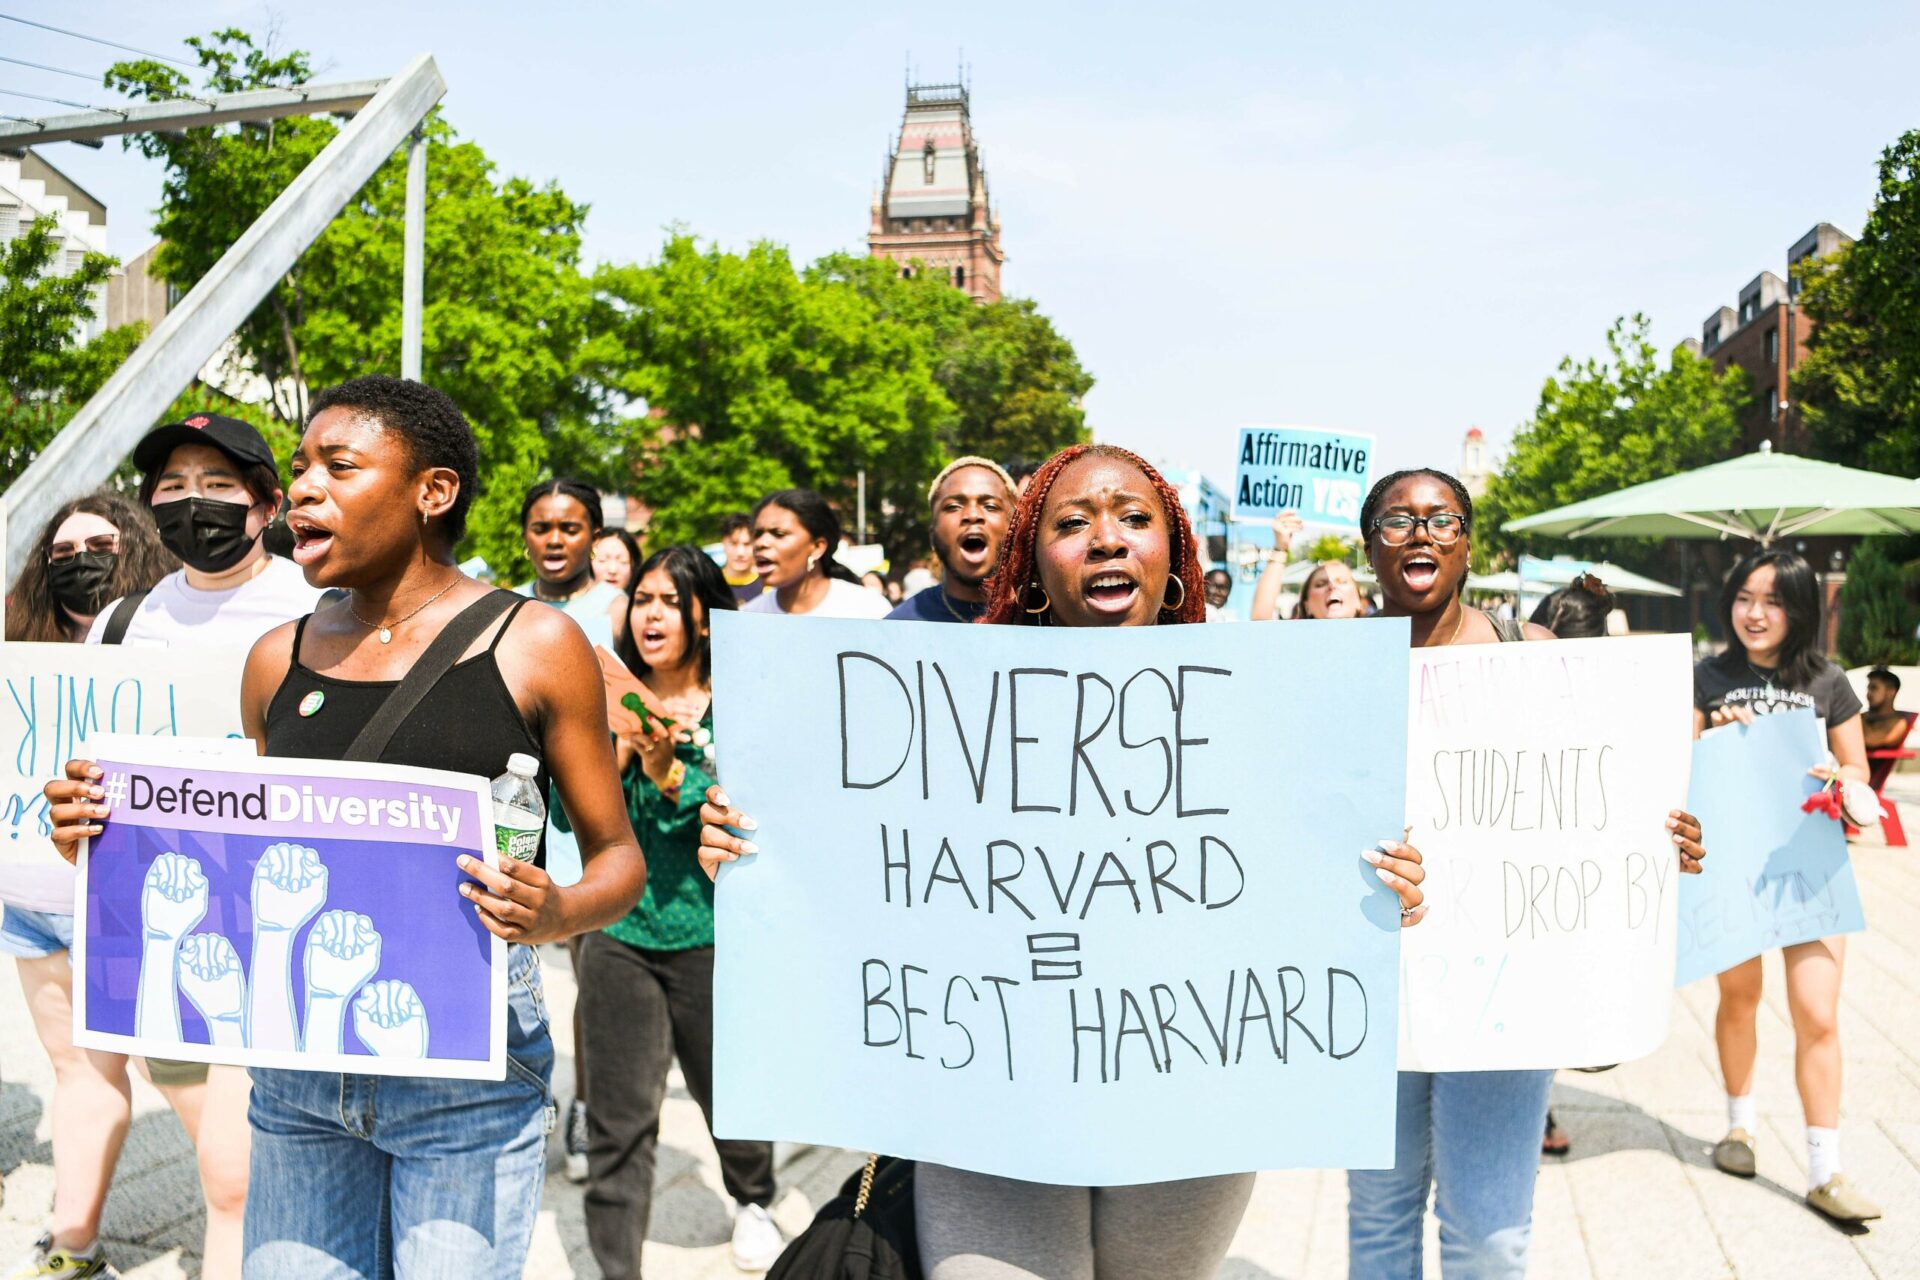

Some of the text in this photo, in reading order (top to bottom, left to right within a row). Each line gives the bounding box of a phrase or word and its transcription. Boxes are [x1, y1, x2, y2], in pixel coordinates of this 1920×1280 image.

[1238, 474, 1362, 521] Action YES
[1241, 433, 1366, 475] Affirmative
[836, 651, 1233, 819] DIVERSE
[104, 772, 462, 842] #DefendDiversity
[1433, 745, 1613, 831] STUDENTS
[880, 823, 1245, 920] HARVARD
[1503, 860, 1602, 939] DROP
[1626, 852, 1671, 945] BY
[862, 958, 1368, 1083] BEST HARVARD
